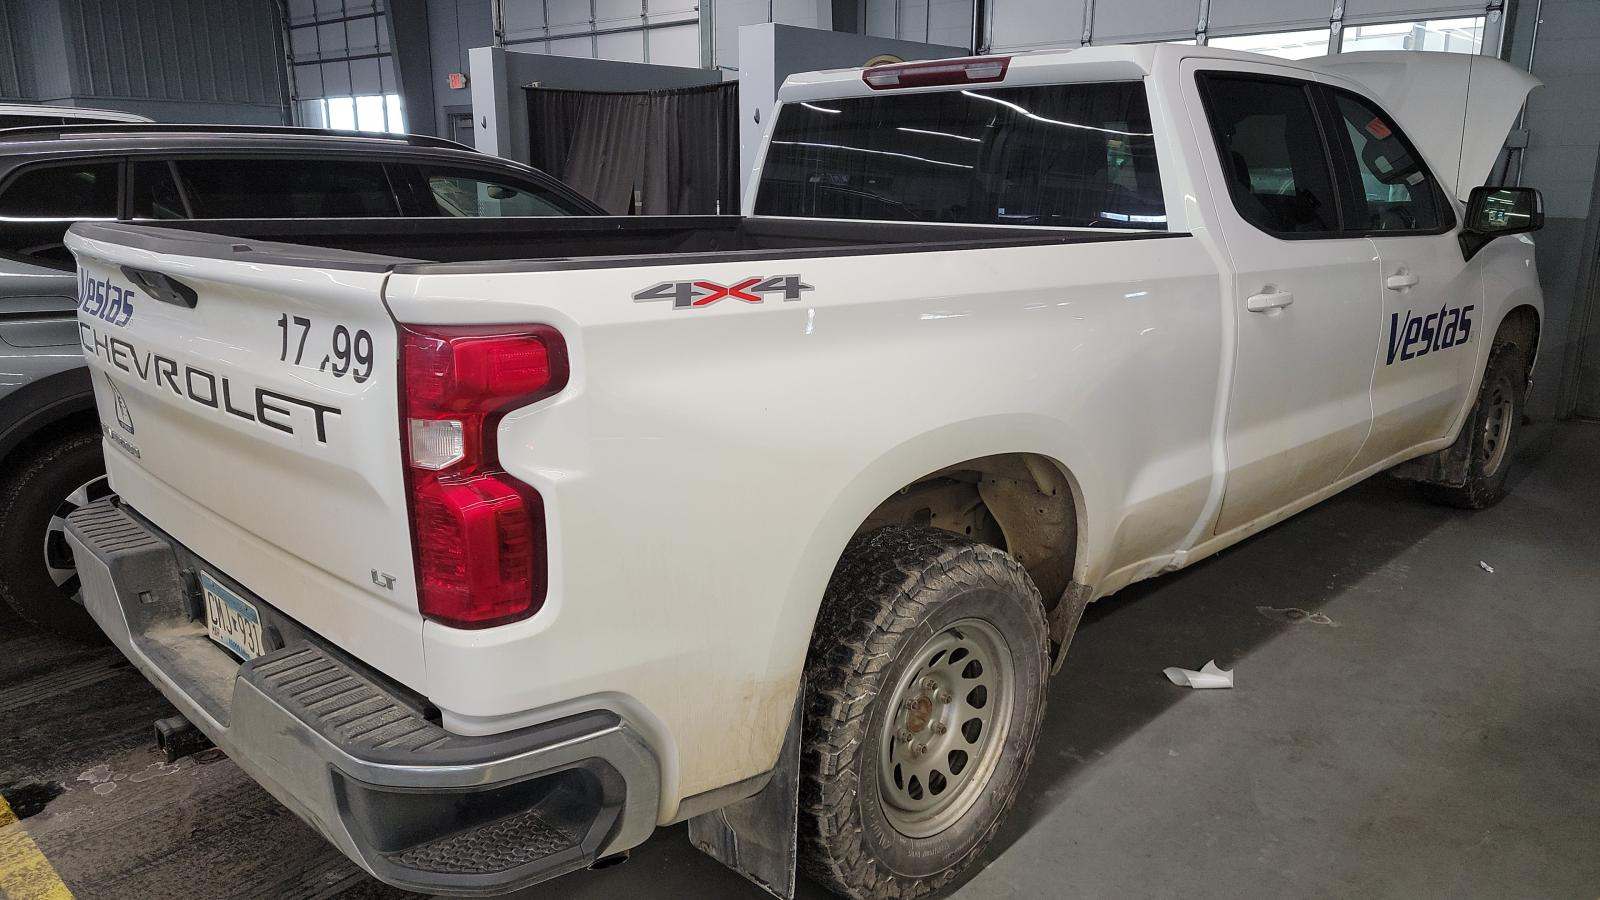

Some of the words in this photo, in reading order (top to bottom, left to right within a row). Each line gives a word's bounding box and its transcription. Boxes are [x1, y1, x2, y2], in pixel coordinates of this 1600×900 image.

[78, 267, 135, 328] Vestas
[1386, 302, 1475, 366] Vestas
[79, 322, 342, 444] CHEVROLET
[370, 568, 397, 591] LT
